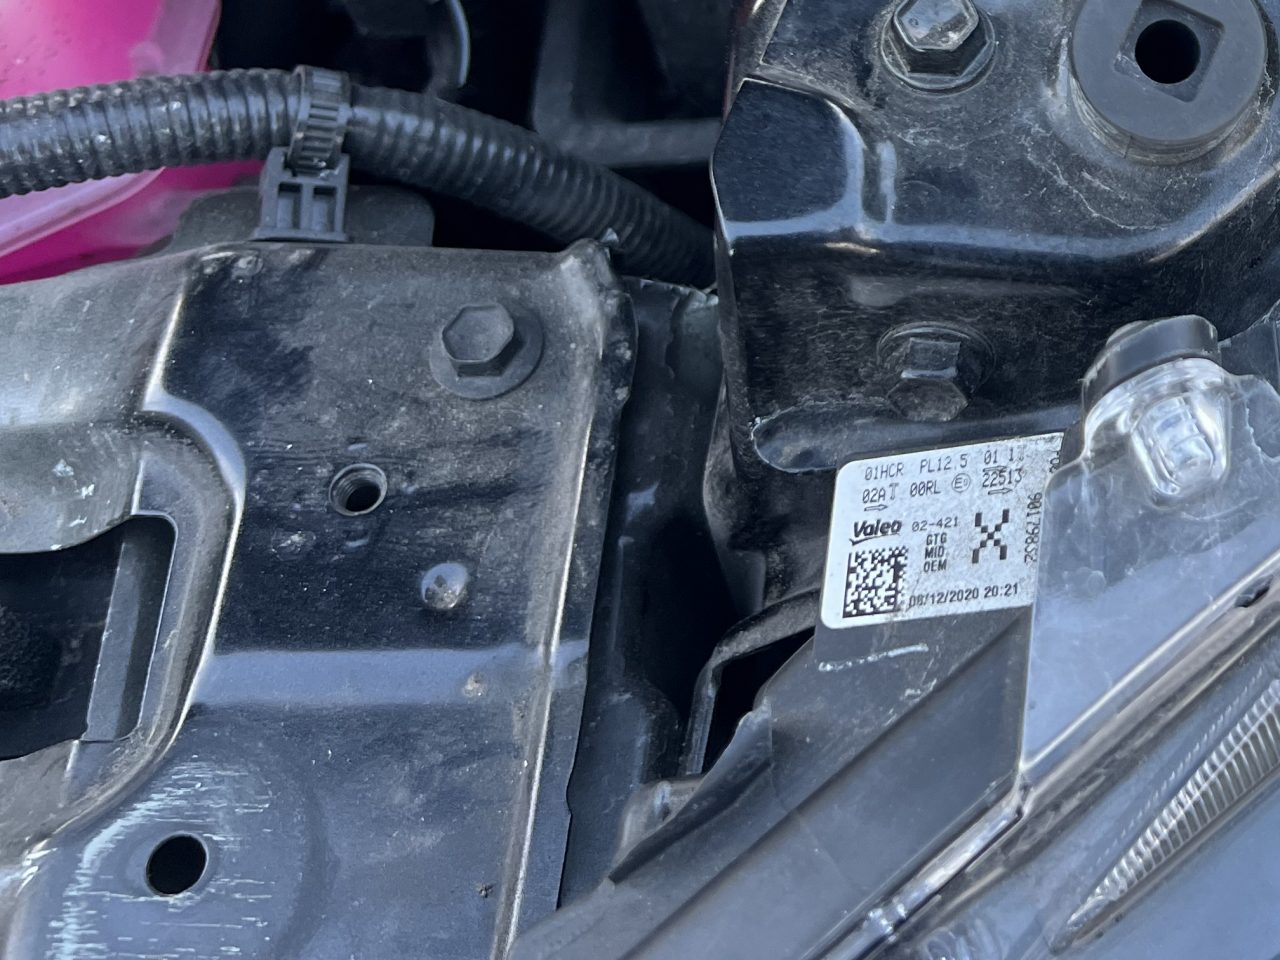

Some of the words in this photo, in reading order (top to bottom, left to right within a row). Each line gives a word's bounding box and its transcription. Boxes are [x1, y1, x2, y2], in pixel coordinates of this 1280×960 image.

[864, 462, 905, 481] 01HCR
[983, 449, 998, 466] 01
[909, 480, 943, 498] 00RL
[982, 468, 1023, 488] 22513
[853, 519, 902, 538] Valeo
[911, 516, 958, 533] 02-421
[926, 532, 948, 546] GTG
[924, 545, 945, 560] MID
[922, 559, 947, 573] OEM
[983, 581, 1019, 599] 20:21
